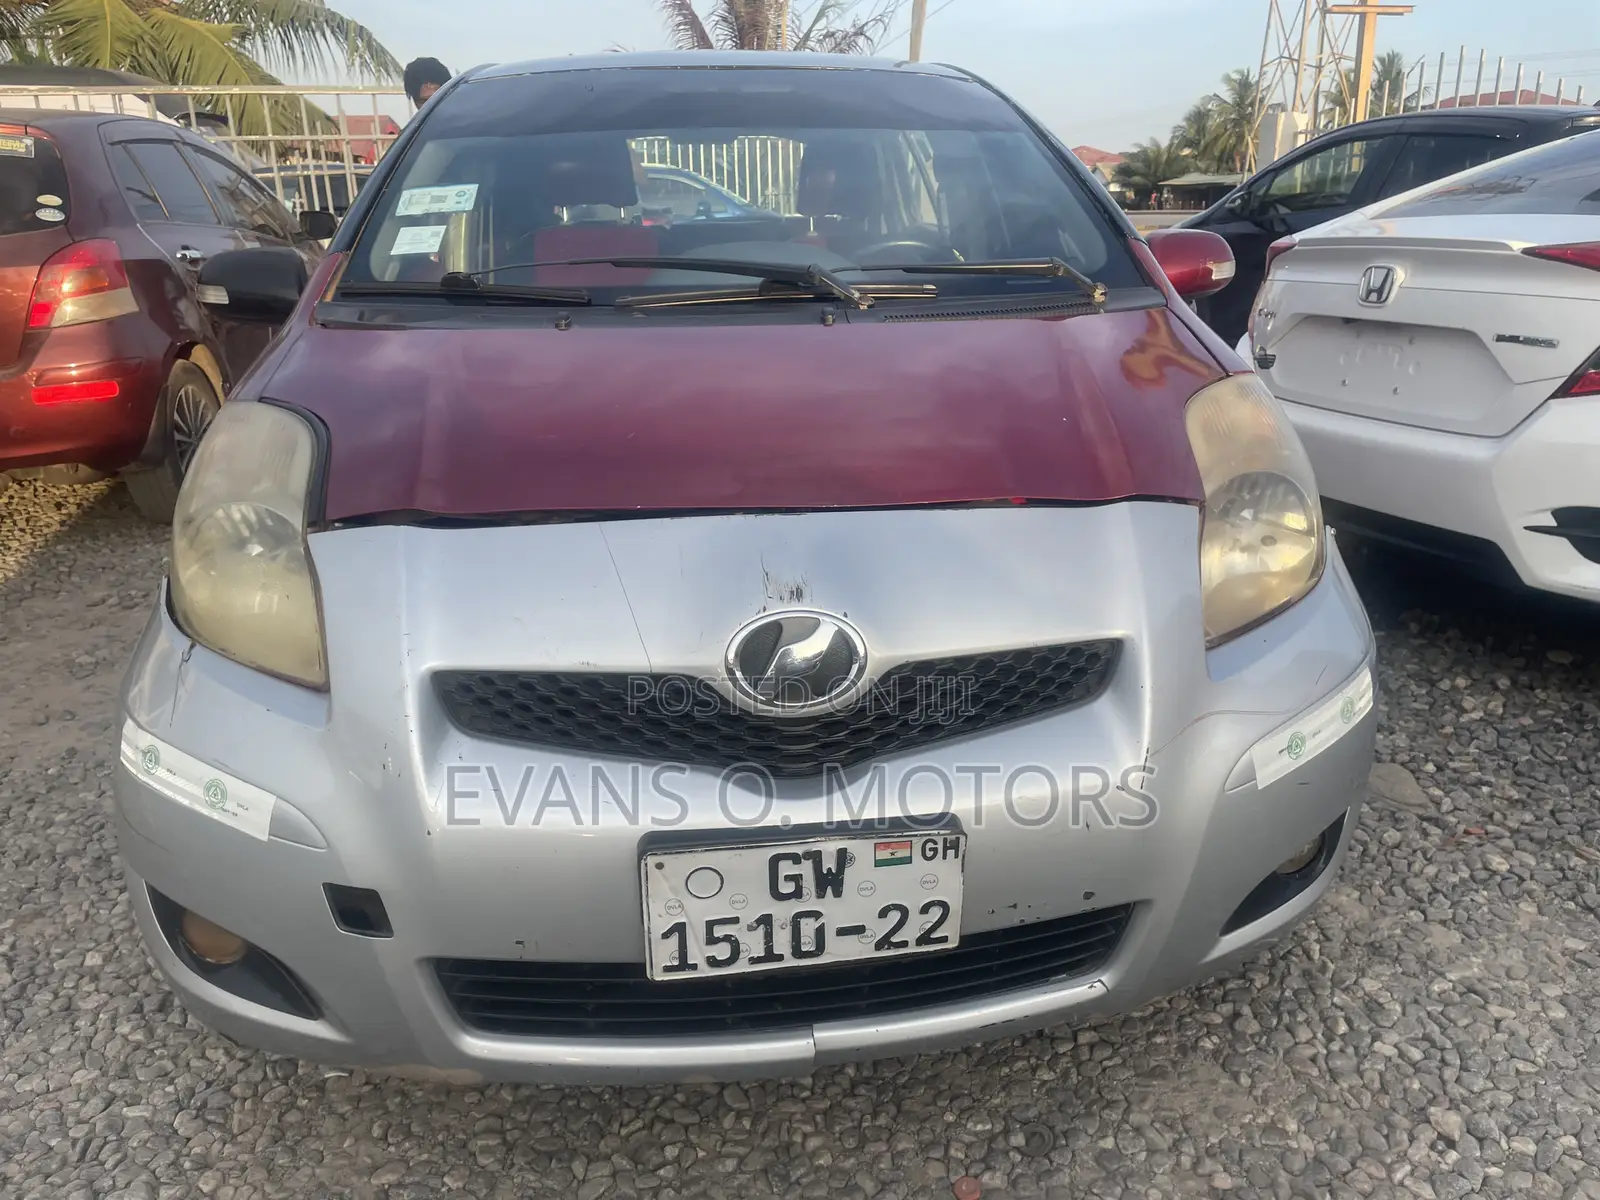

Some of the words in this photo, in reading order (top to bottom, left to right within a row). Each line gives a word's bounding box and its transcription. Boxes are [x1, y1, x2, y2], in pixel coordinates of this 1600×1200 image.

[921, 836, 960, 861] GH
[768, 847, 848, 901] GW
[666, 903, 682, 911] DVLA
[661, 899, 951, 973] 1510-22
